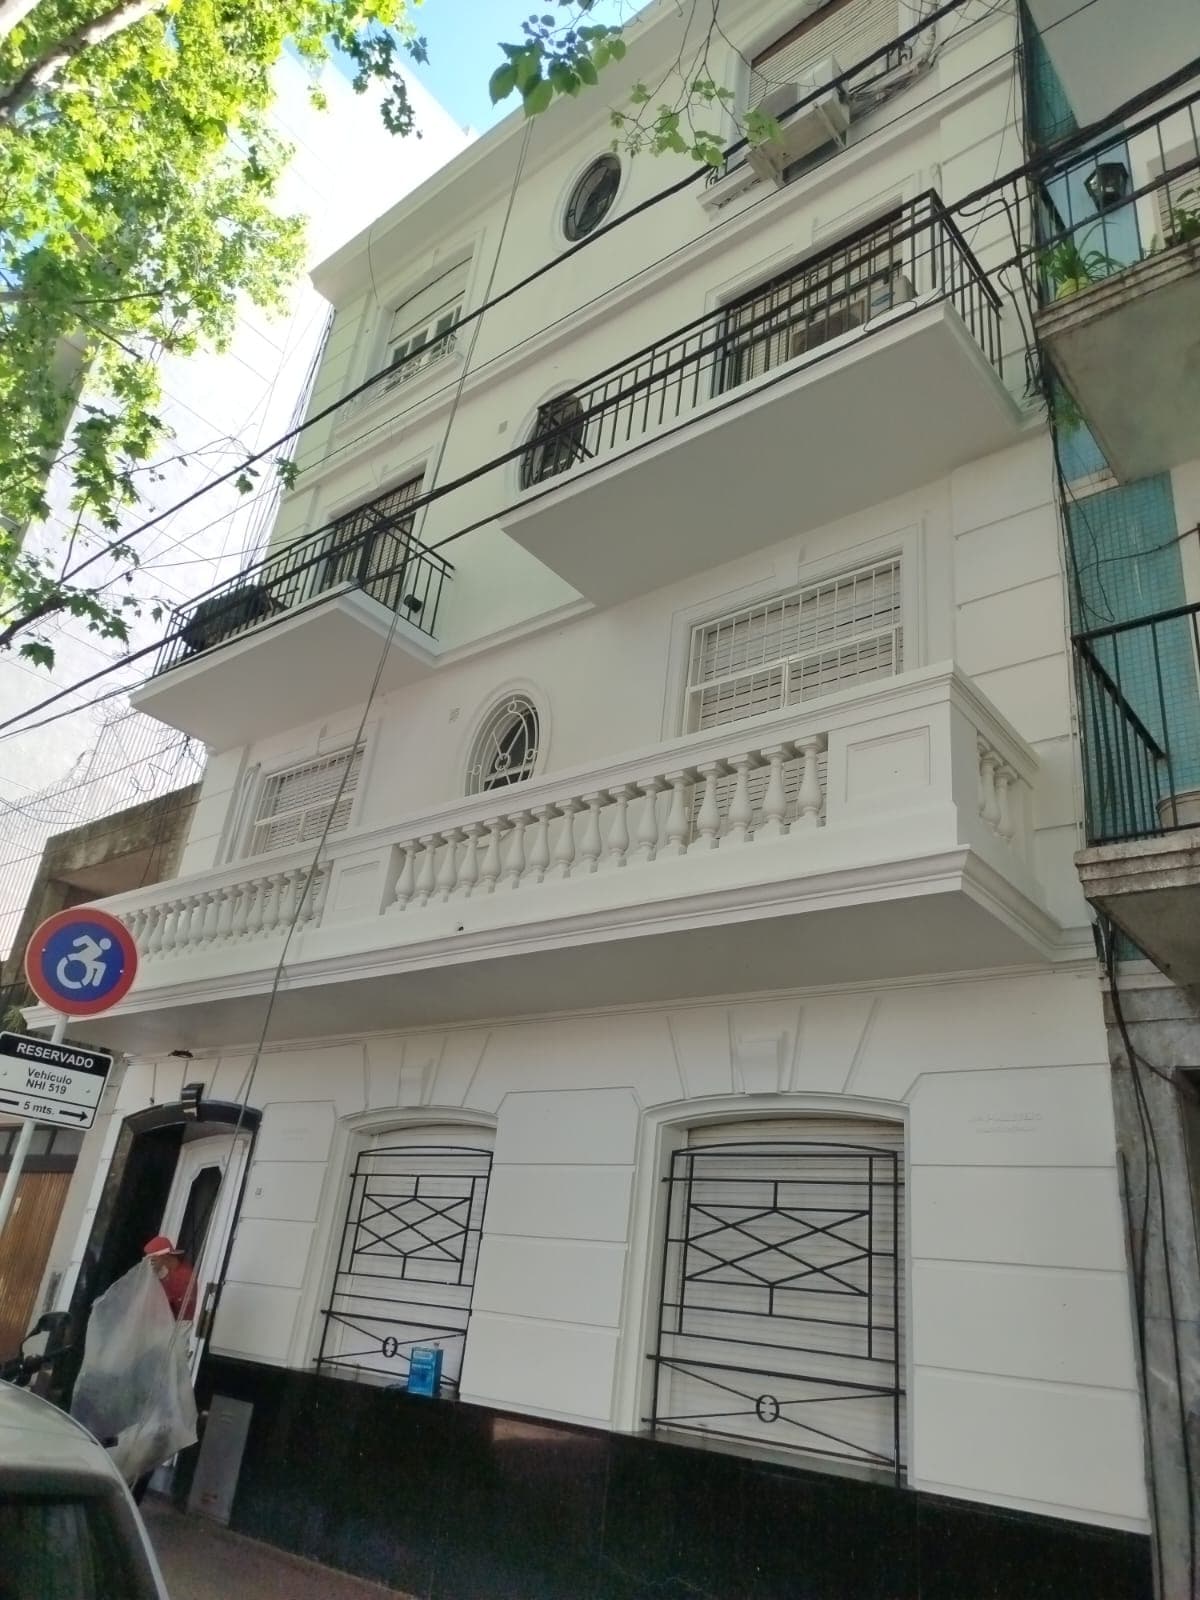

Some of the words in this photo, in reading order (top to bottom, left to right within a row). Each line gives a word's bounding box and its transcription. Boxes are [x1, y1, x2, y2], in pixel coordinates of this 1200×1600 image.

[16, 1043, 94, 1068] RESERVADO
[26, 1079, 47, 1091] NHI
[48, 1083, 67, 1095] 519
[23, 1102, 30, 1110] 5
[32, 1104, 55, 1115] mts.
